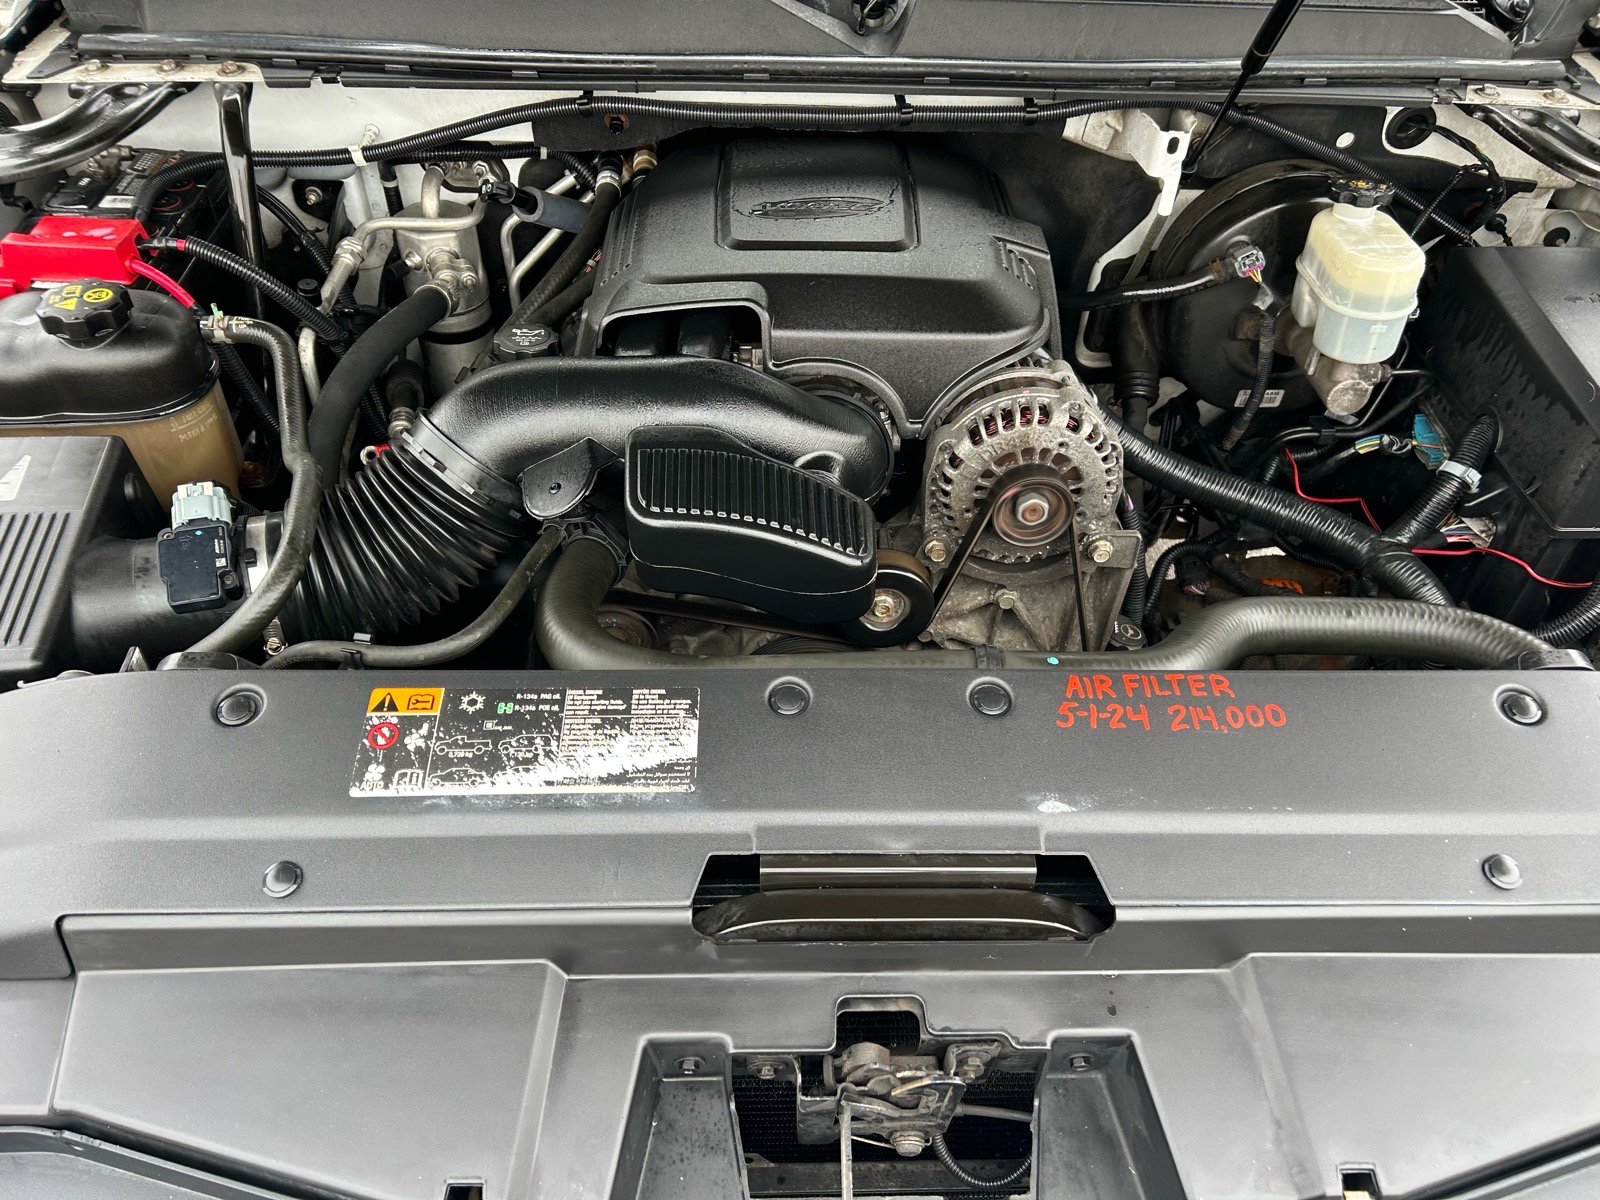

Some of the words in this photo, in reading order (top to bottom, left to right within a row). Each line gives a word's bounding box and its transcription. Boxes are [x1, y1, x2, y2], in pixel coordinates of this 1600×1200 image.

[1066, 674, 1117, 699] AIR
[1122, 674, 1236, 699] FILTER
[1056, 701, 1151, 731] 5-1-24
